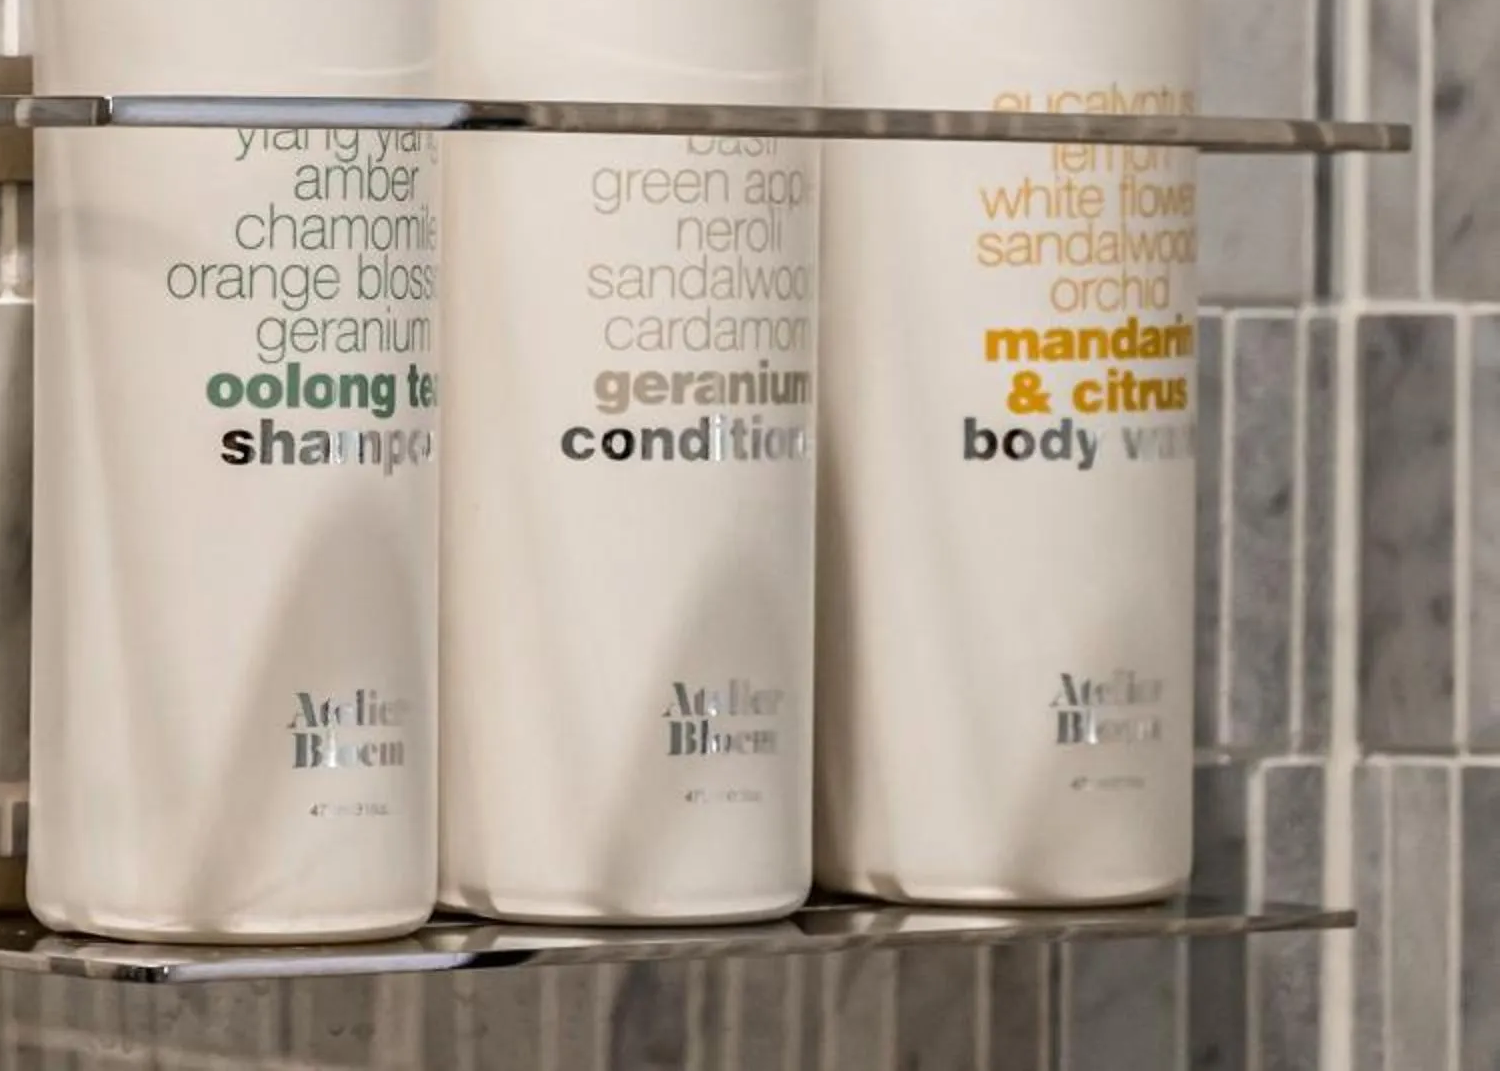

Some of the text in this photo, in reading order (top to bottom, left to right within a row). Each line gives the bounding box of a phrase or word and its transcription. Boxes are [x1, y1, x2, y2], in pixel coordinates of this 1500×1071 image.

[294, 154, 420, 201] amber
[591, 167, 730, 215] green
[979, 176, 1105, 220] white
[677, 207, 782, 253] neroli
[166, 262, 341, 311] orange
[1050, 269, 1169, 313] orchid
[256, 305, 432, 364] geranium
[206, 362, 397, 419] oolong
[1005, 368, 1188, 414] & citrus
[964, 417, 1098, 470] body
